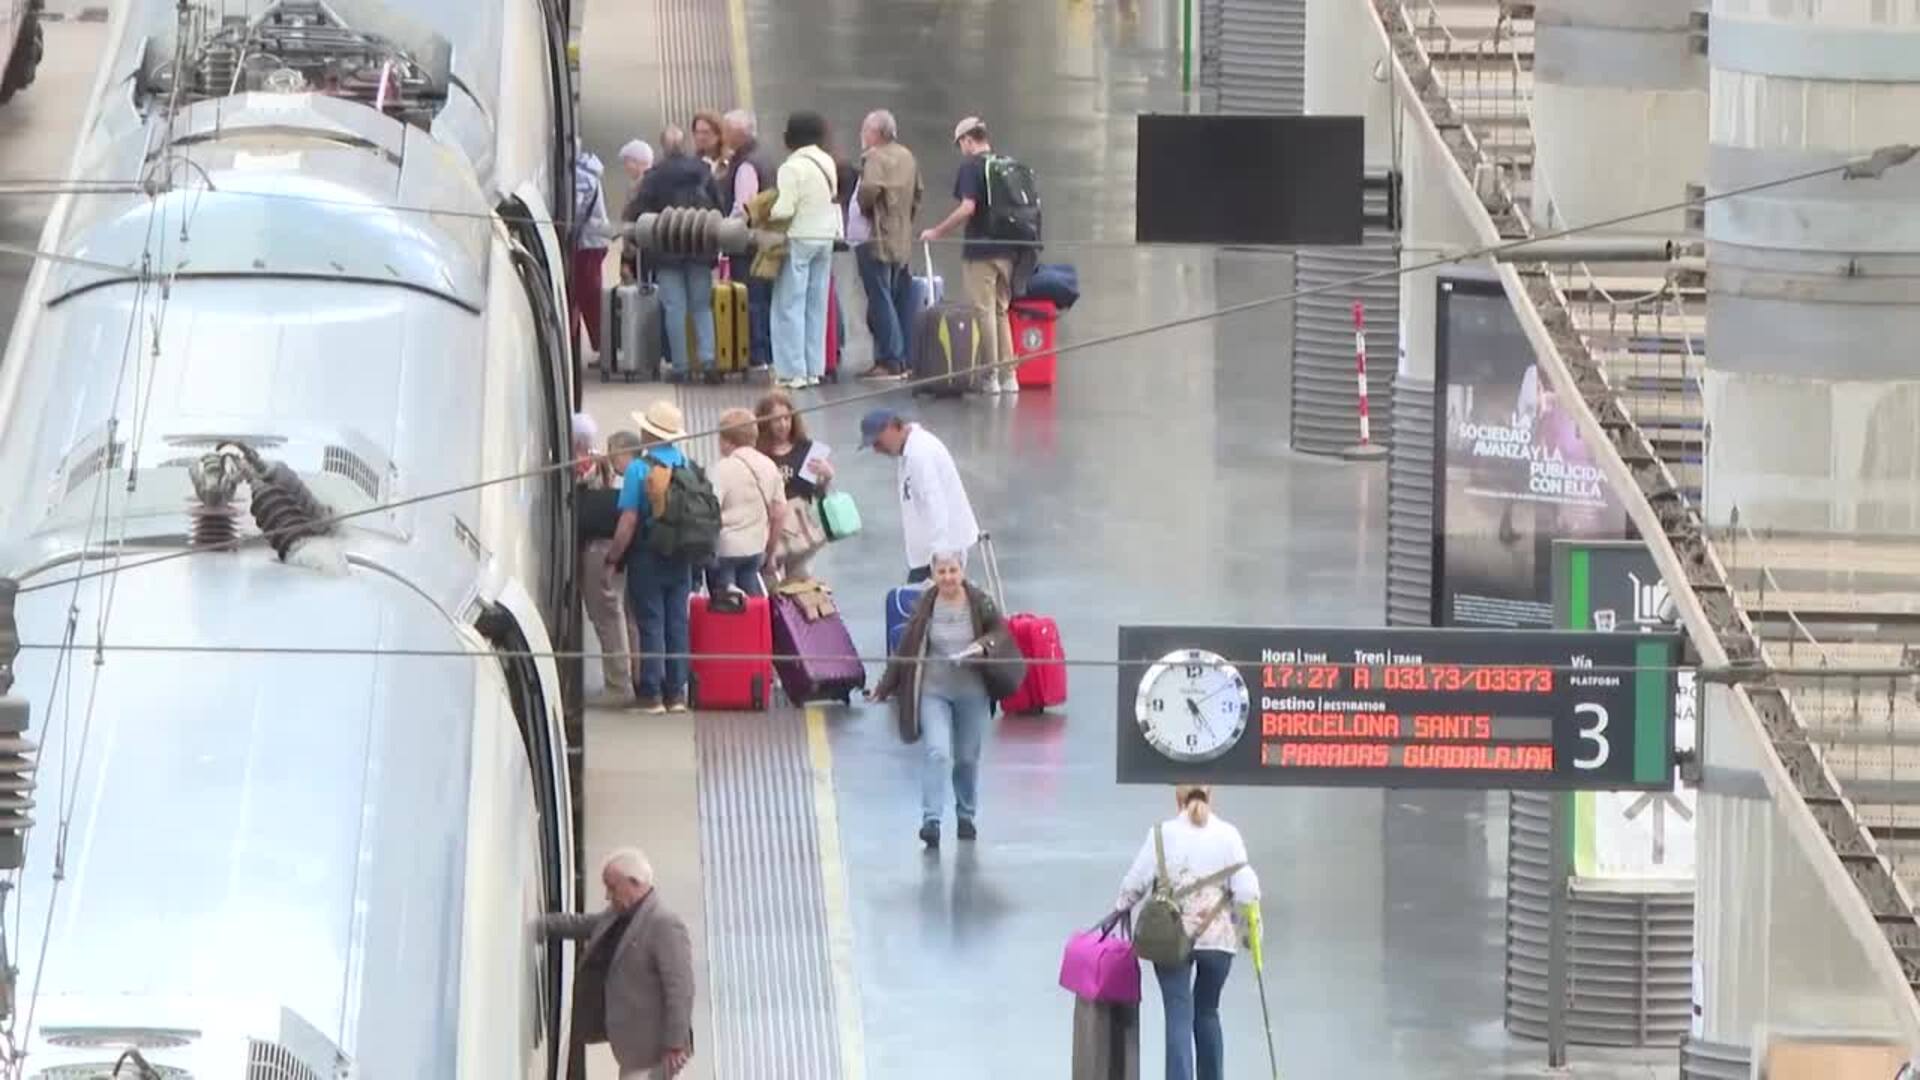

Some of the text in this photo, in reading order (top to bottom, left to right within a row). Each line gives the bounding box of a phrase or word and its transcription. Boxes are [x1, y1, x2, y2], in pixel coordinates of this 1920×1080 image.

[1511, 410, 1531, 428] LA
[1459, 422, 1531, 444] SOCIEDAD
[1543, 445, 1563, 462] LA
[1530, 461, 1609, 483] PUBLICIDA
[1529, 477, 1562, 494] CON
[1564, 480, 1602, 498] ELLA
[1261, 648, 1327, 664] Hora TIME
[1354, 650, 1384, 664] Tren
[1571, 654, 1593, 669] Vía
[1262, 665, 1553, 691] 17:27 A 03173/03373
[1570, 676, 1620, 686] PLATFORM
[1261, 696, 1316, 711] Destino
[1262, 713, 1490, 738] BARCELONA SANTS
[1573, 702, 1610, 770] 3
[1281, 743, 1389, 767] PARADAS
